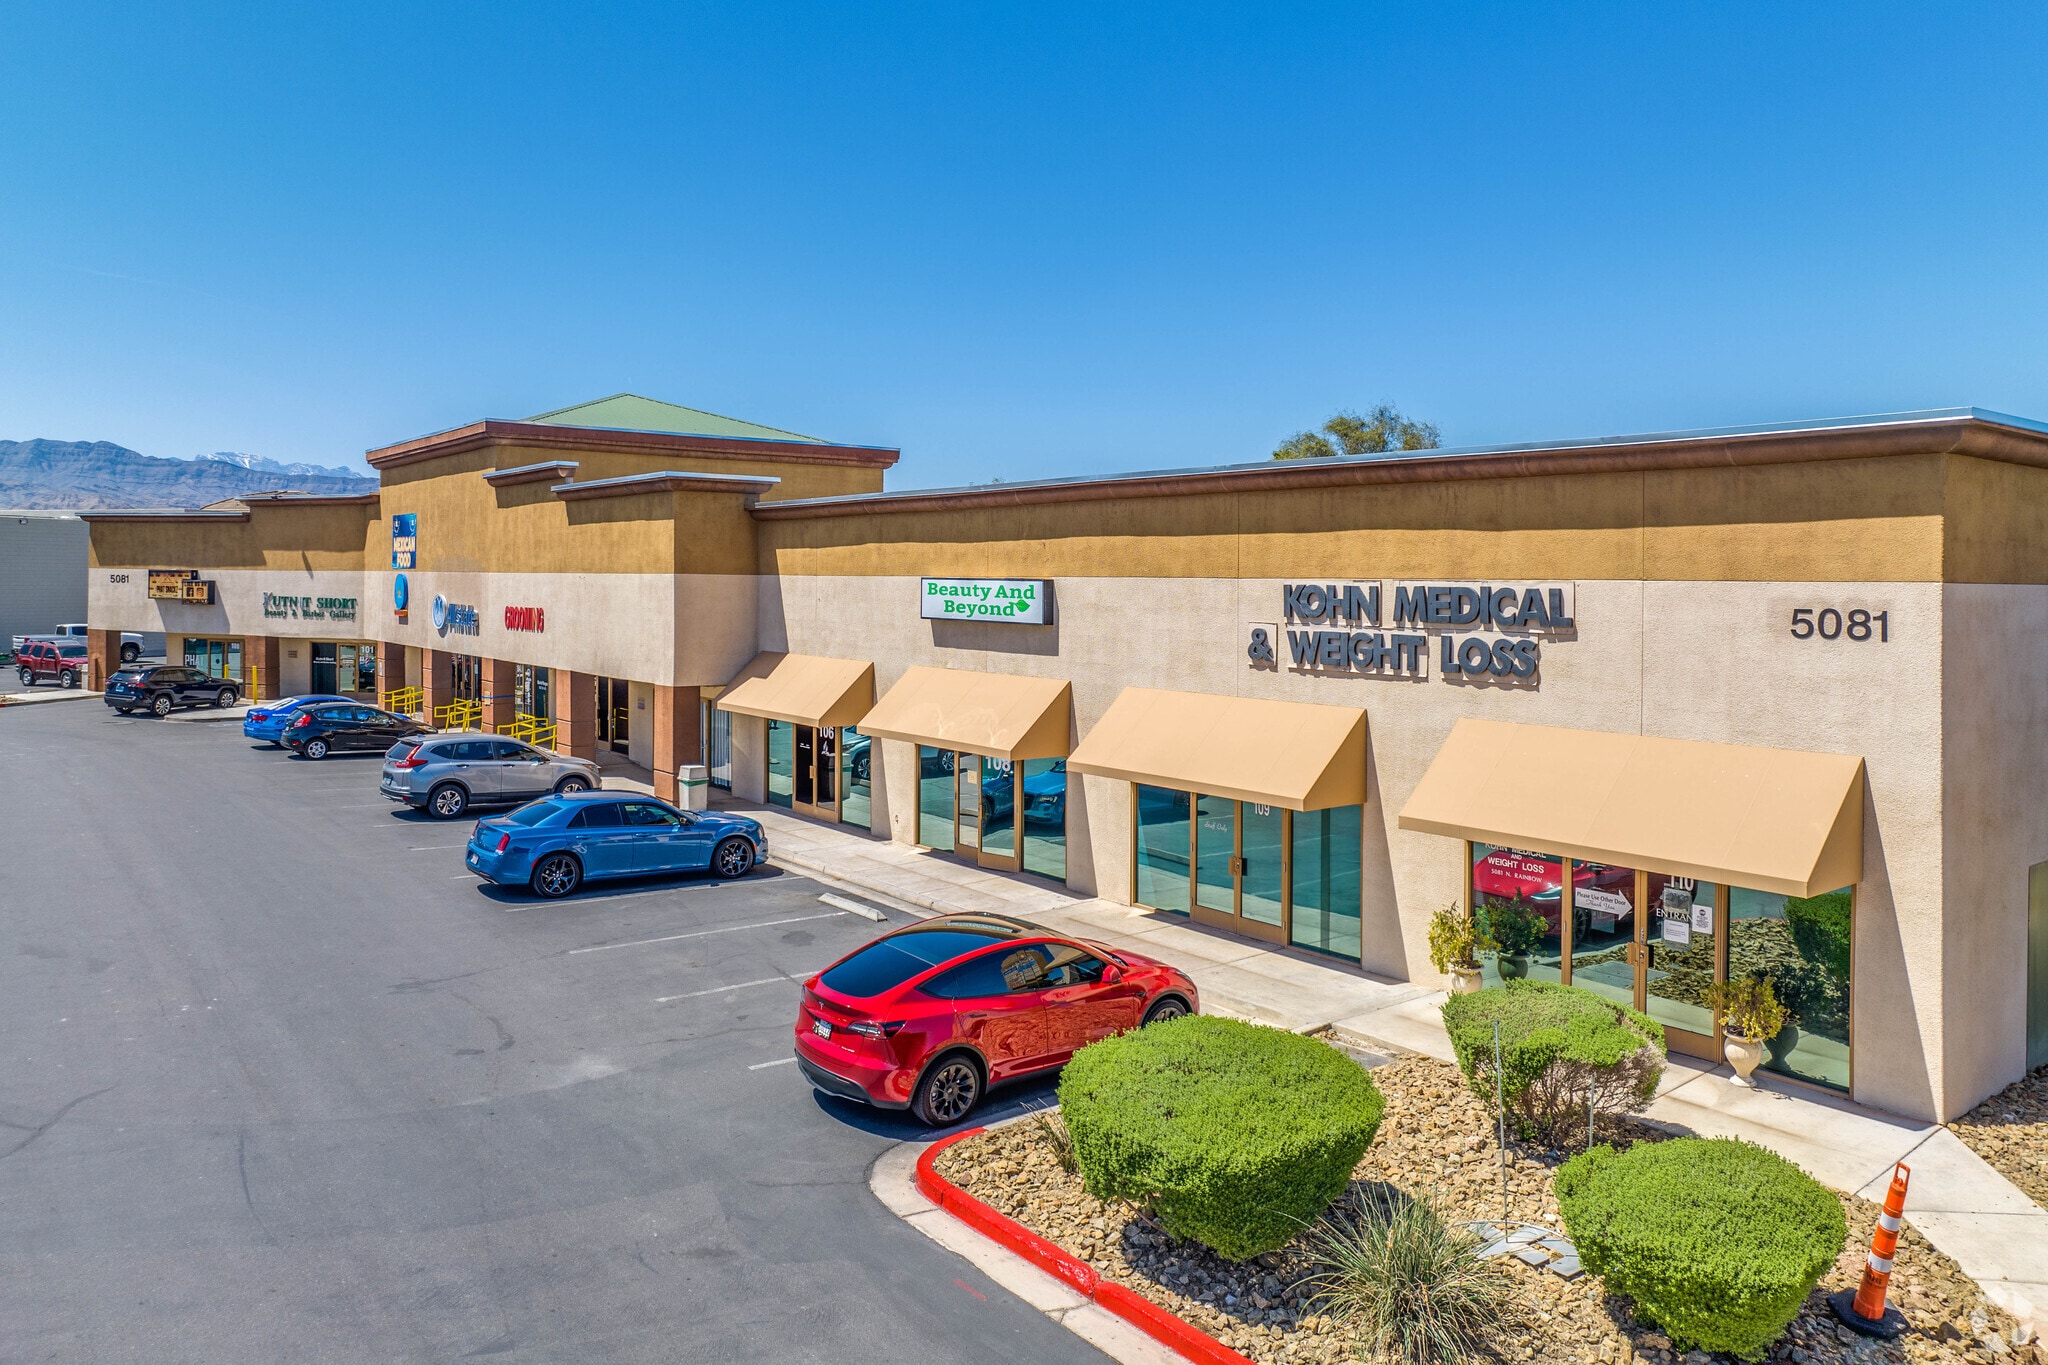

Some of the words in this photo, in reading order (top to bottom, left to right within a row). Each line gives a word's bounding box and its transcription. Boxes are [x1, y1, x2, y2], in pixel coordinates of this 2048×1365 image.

[393, 537, 415, 552] MEXICAN
[397, 552, 411, 568] FOOD
[110, 574, 129, 584] 5081
[927, 582, 992, 601] Beauty
[994, 585, 1036, 600] And
[316, 597, 357, 609] SHORT
[943, 600, 1016, 618] Beyond
[1283, 584, 1379, 622] KOHN
[1393, 586, 1574, 629] MEDICAL
[264, 609, 287, 618] Beauty
[329, 610, 356, 620] Gallery
[504, 606, 544, 633] GROOMING
[1790, 608, 1888, 643] 5081
[185, 655, 203, 665] PHAT
[1248, 628, 1274, 662] &
[1286, 630, 1427, 672] WEIGHT
[1441, 635, 1538, 679] LOSS
[820, 726, 834, 739] 106
[985, 757, 1011, 772] 108
[1254, 803, 1271, 816] 109
[1487, 856, 1518, 869] WEIGHT
[1522, 863, 1545, 874] LOSS
[1514, 873, 1542, 883] RAINBOW
[1671, 876, 1694, 891] 110
[1577, 891, 1590, 899] Please
[1614, 898, 1626, 906] Door
[1656, 908, 1693, 922] ENTRAN
